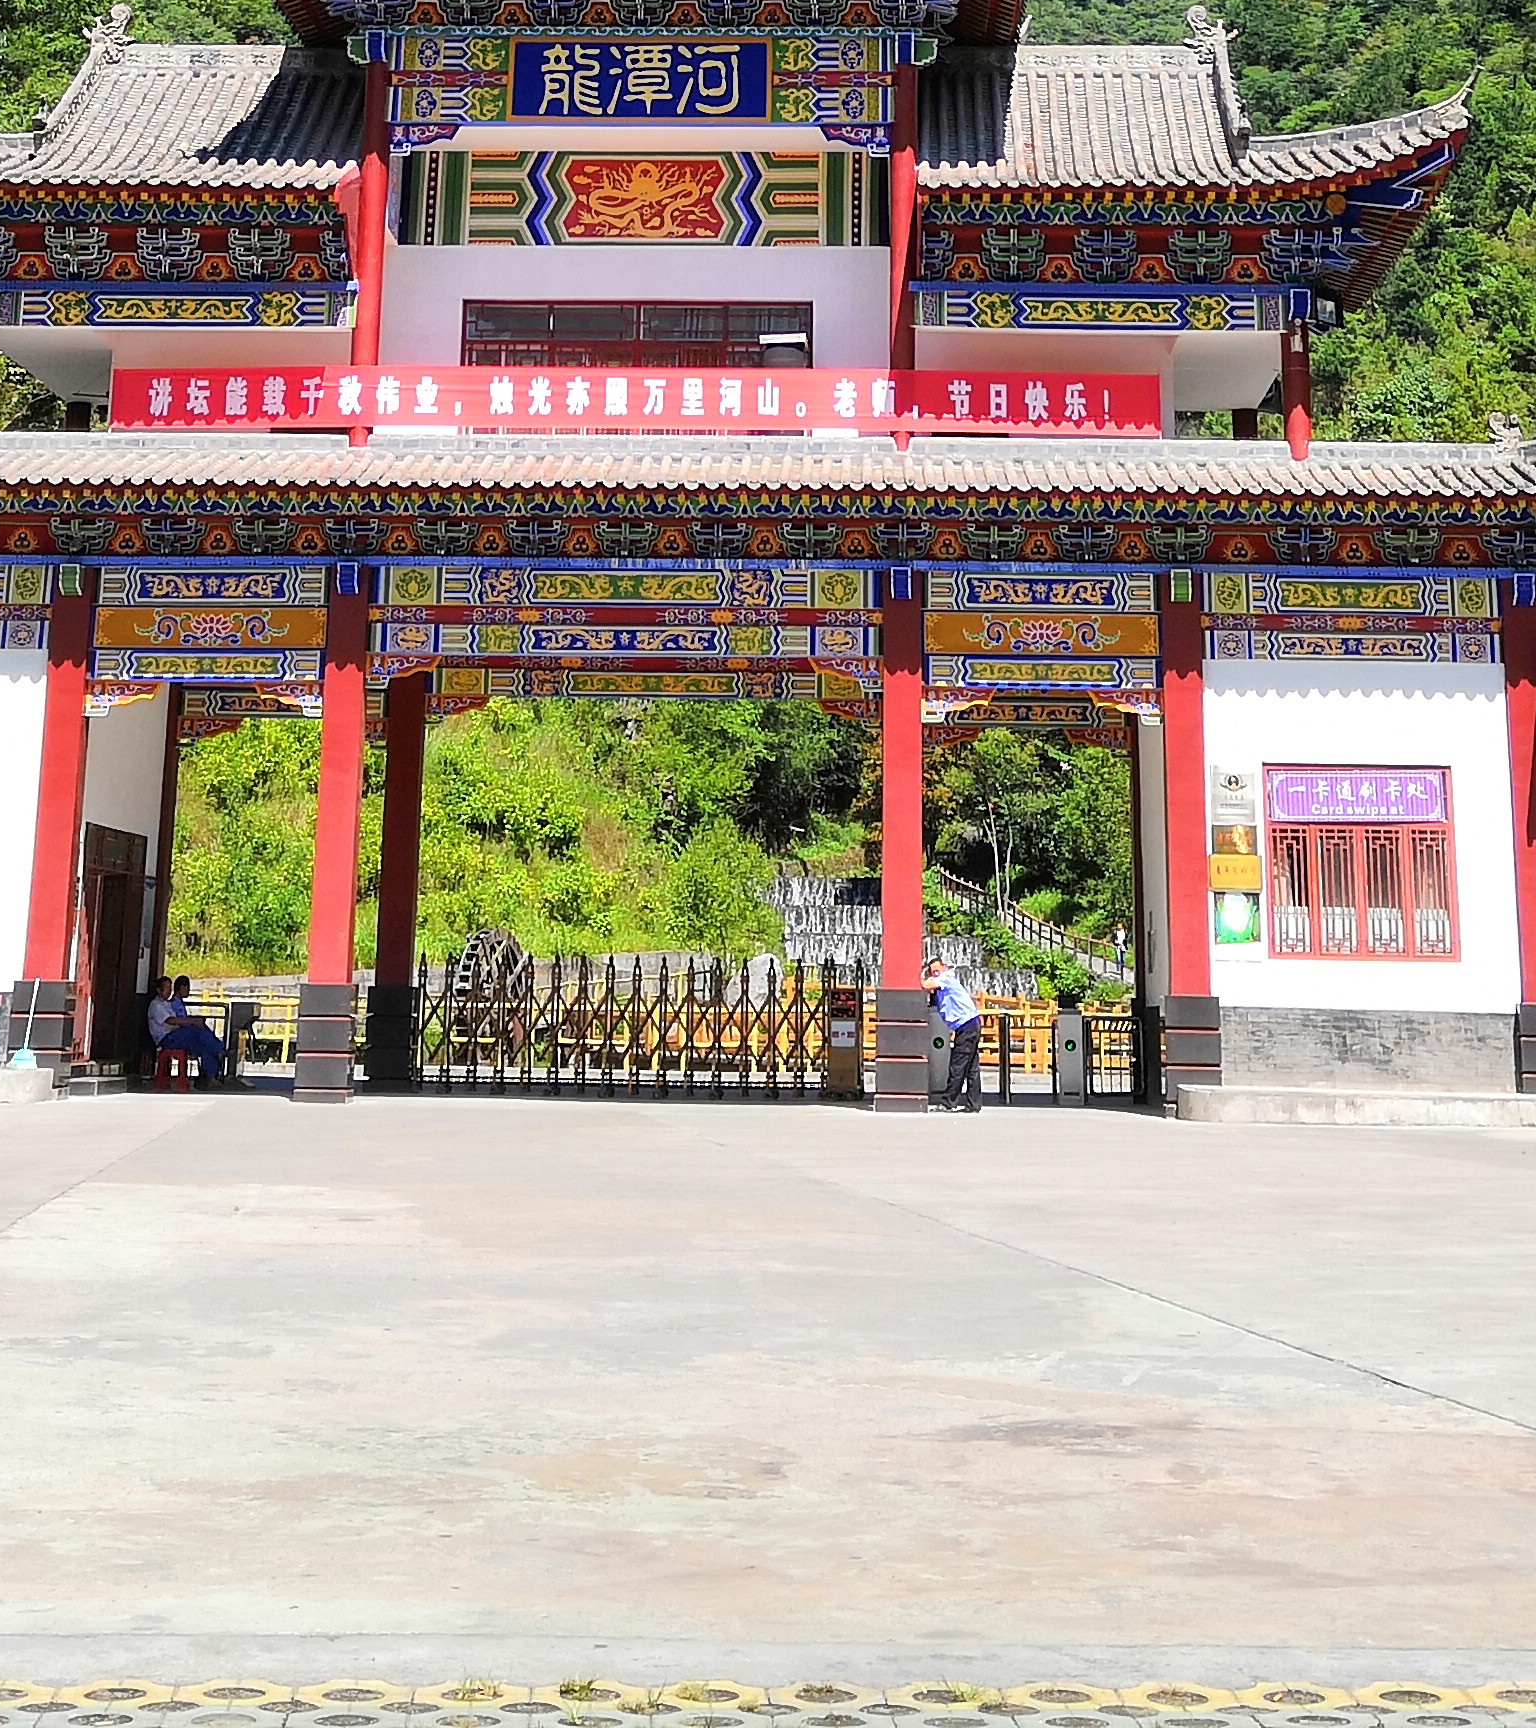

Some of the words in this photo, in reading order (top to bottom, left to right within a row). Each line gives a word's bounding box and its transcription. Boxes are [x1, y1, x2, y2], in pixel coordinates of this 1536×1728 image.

[538, 43, 740, 115] 龍潭河
[1287, 778, 1429, 802] 一卡通刷卡处
[1311, 804, 1342, 815] Card
[1346, 804, 1388, 817] swipe
[1391, 805, 1405, 815] at
